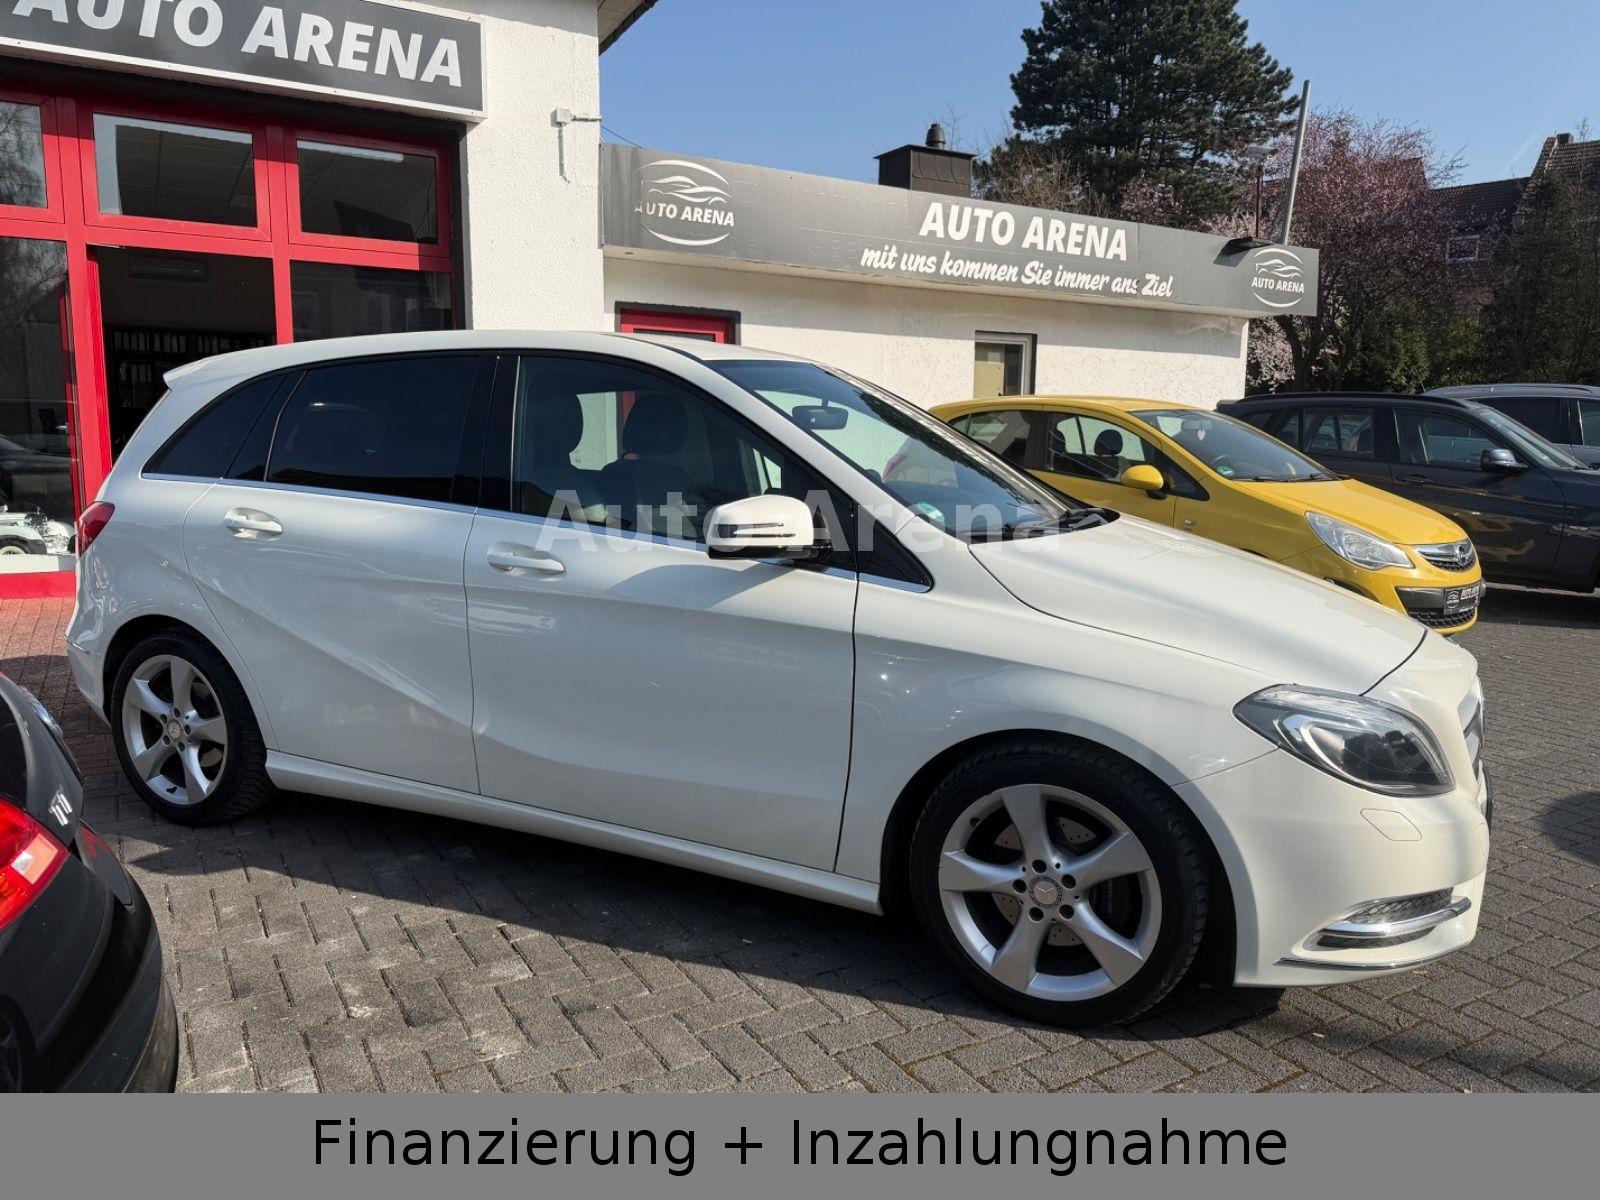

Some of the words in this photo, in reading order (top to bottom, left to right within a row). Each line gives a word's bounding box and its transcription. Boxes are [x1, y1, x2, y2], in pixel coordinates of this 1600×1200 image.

[240, 5, 462, 87] ARENA
[680, 205, 735, 227] ARENA
[919, 202, 1015, 246] AUTO
[1021, 216, 1127, 261] ARENA
[860, 245, 898, 270] mit
[900, 251, 937, 274] uns
[939, 250, 1018, 283] kommen
[1021, 260, 1051, 286] Sie
[1054, 265, 1110, 291] immer
[1141, 273, 1174, 297] Ziel
[1251, 276, 1275, 290] AUTO
[1275, 279, 1305, 294] ARENA
